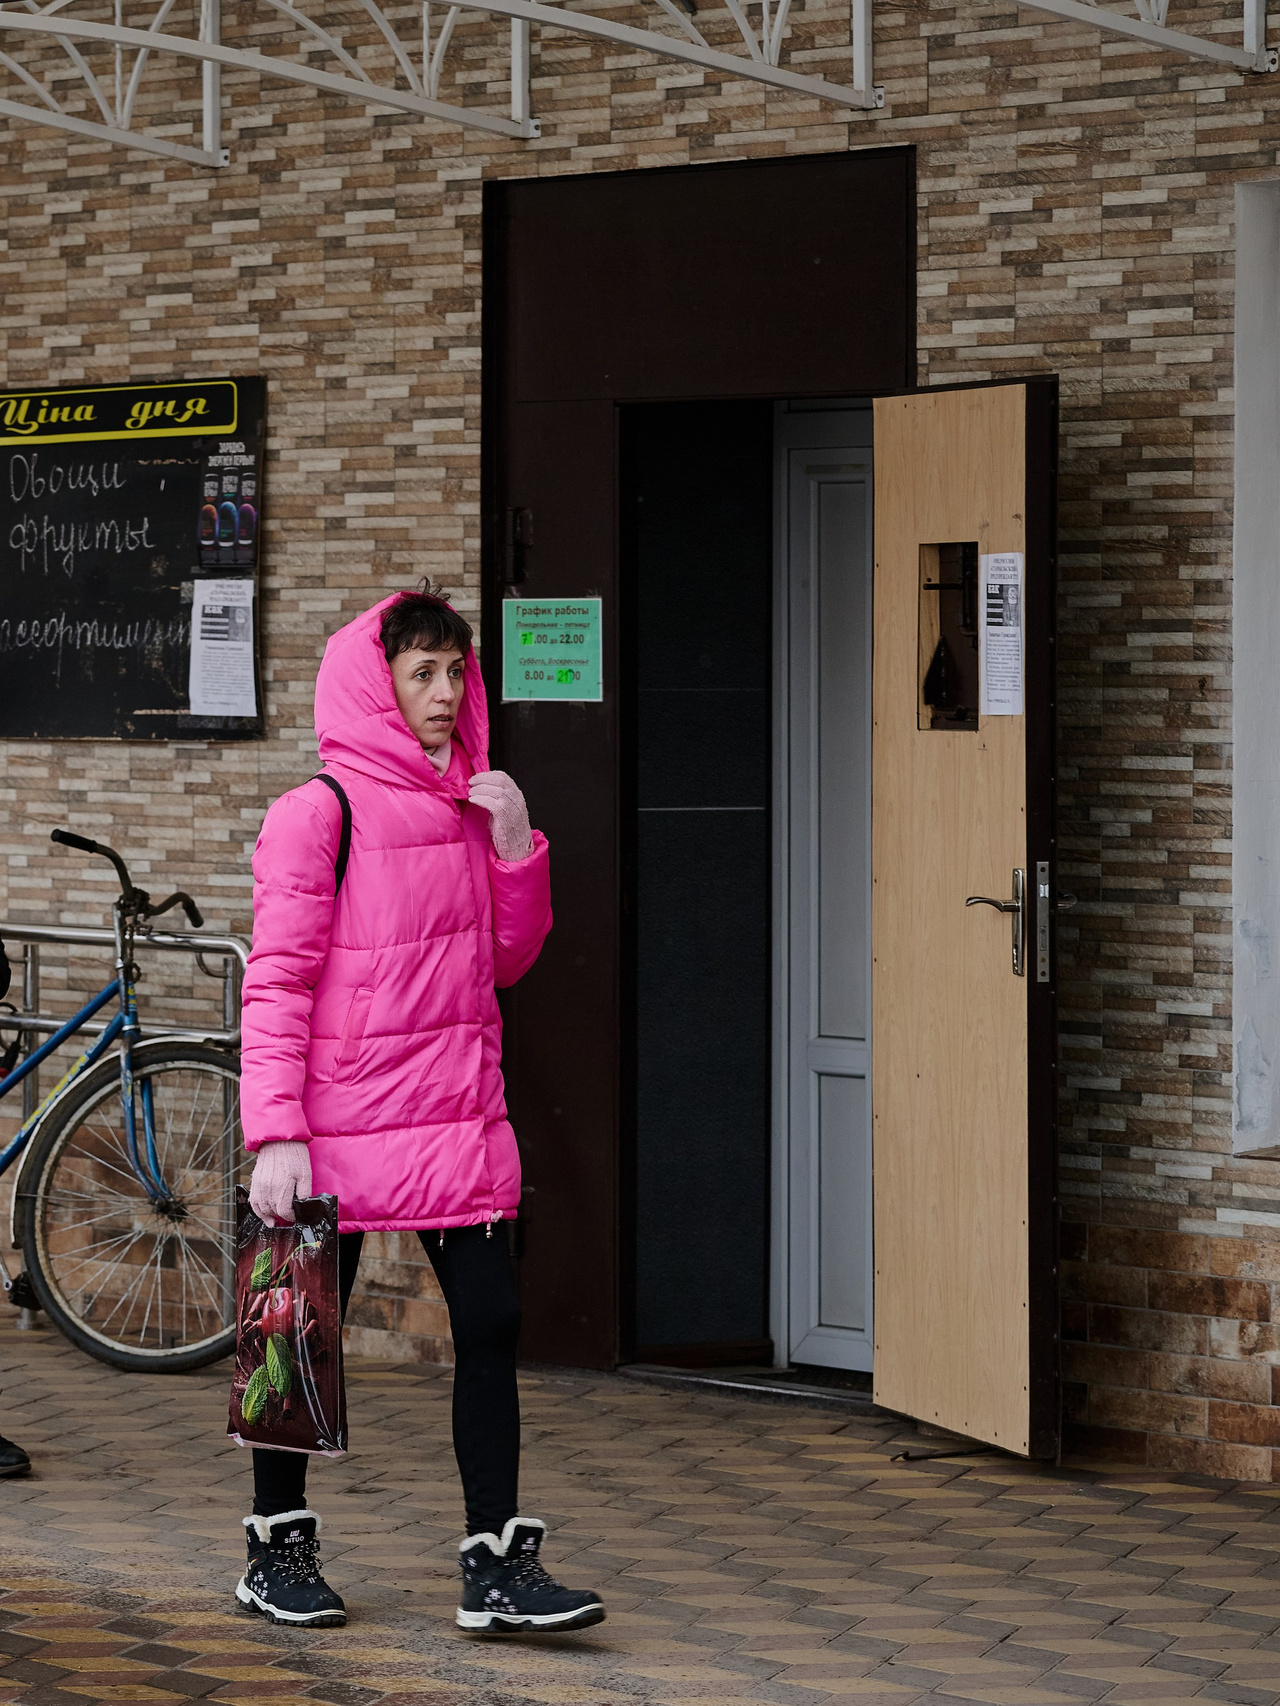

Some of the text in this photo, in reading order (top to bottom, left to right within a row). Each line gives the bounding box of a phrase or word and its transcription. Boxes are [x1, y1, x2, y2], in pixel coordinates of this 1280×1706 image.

[125, 397, 210, 429] дня
[9, 452, 127, 502] Овощи
[9, 513, 157, 579] фрукты
[516, 605, 589, 617] График работы
[560, 634, 585, 644] 22.00
[525, 670, 544, 680] 8.00
[284, 1535, 305, 1544] SITUO
